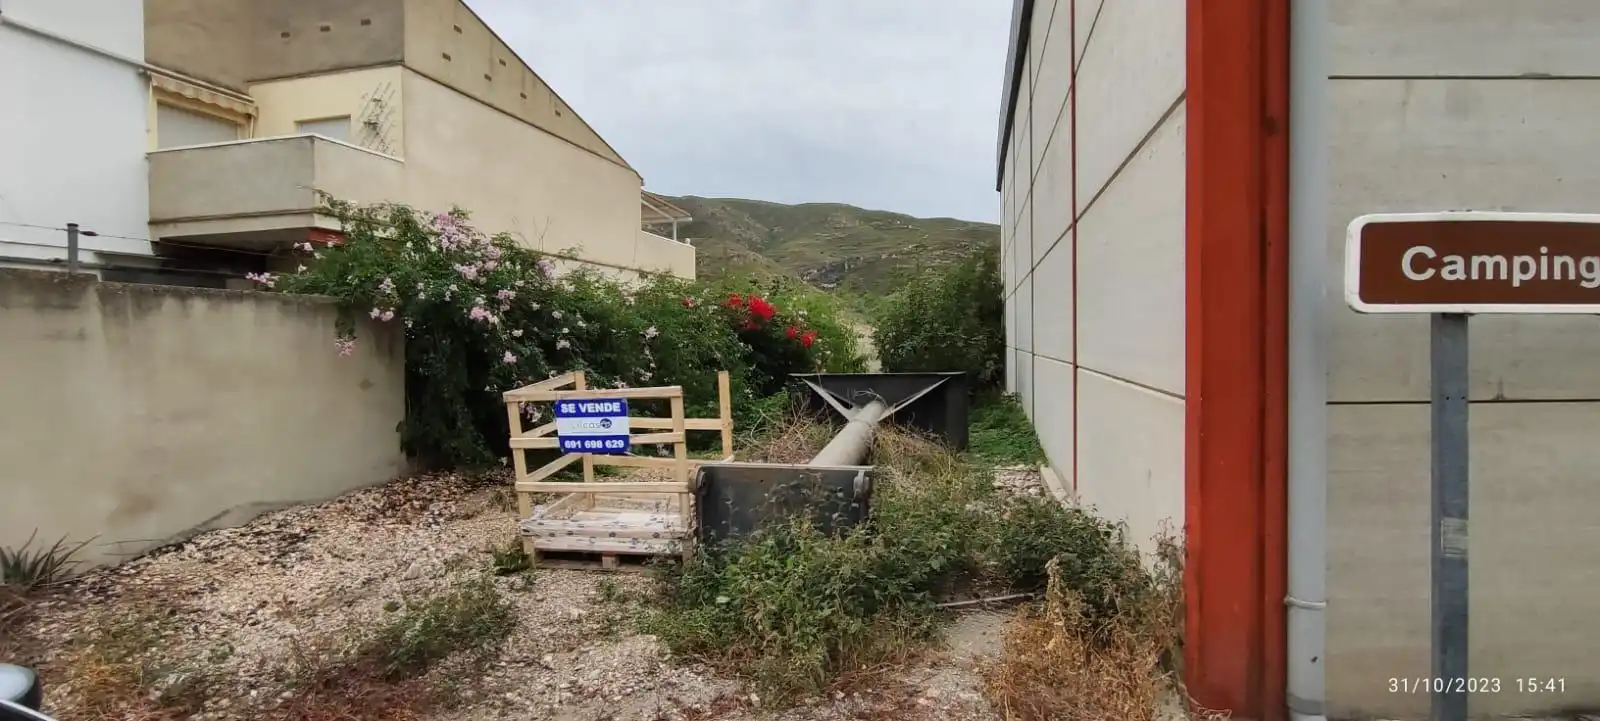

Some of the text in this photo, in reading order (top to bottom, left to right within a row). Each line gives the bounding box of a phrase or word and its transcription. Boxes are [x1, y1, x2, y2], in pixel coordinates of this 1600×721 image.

[1401, 245, 1600, 289] Camping
[560, 402, 621, 414] SE VENDE
[564, 439, 625, 449] 691 698 629
